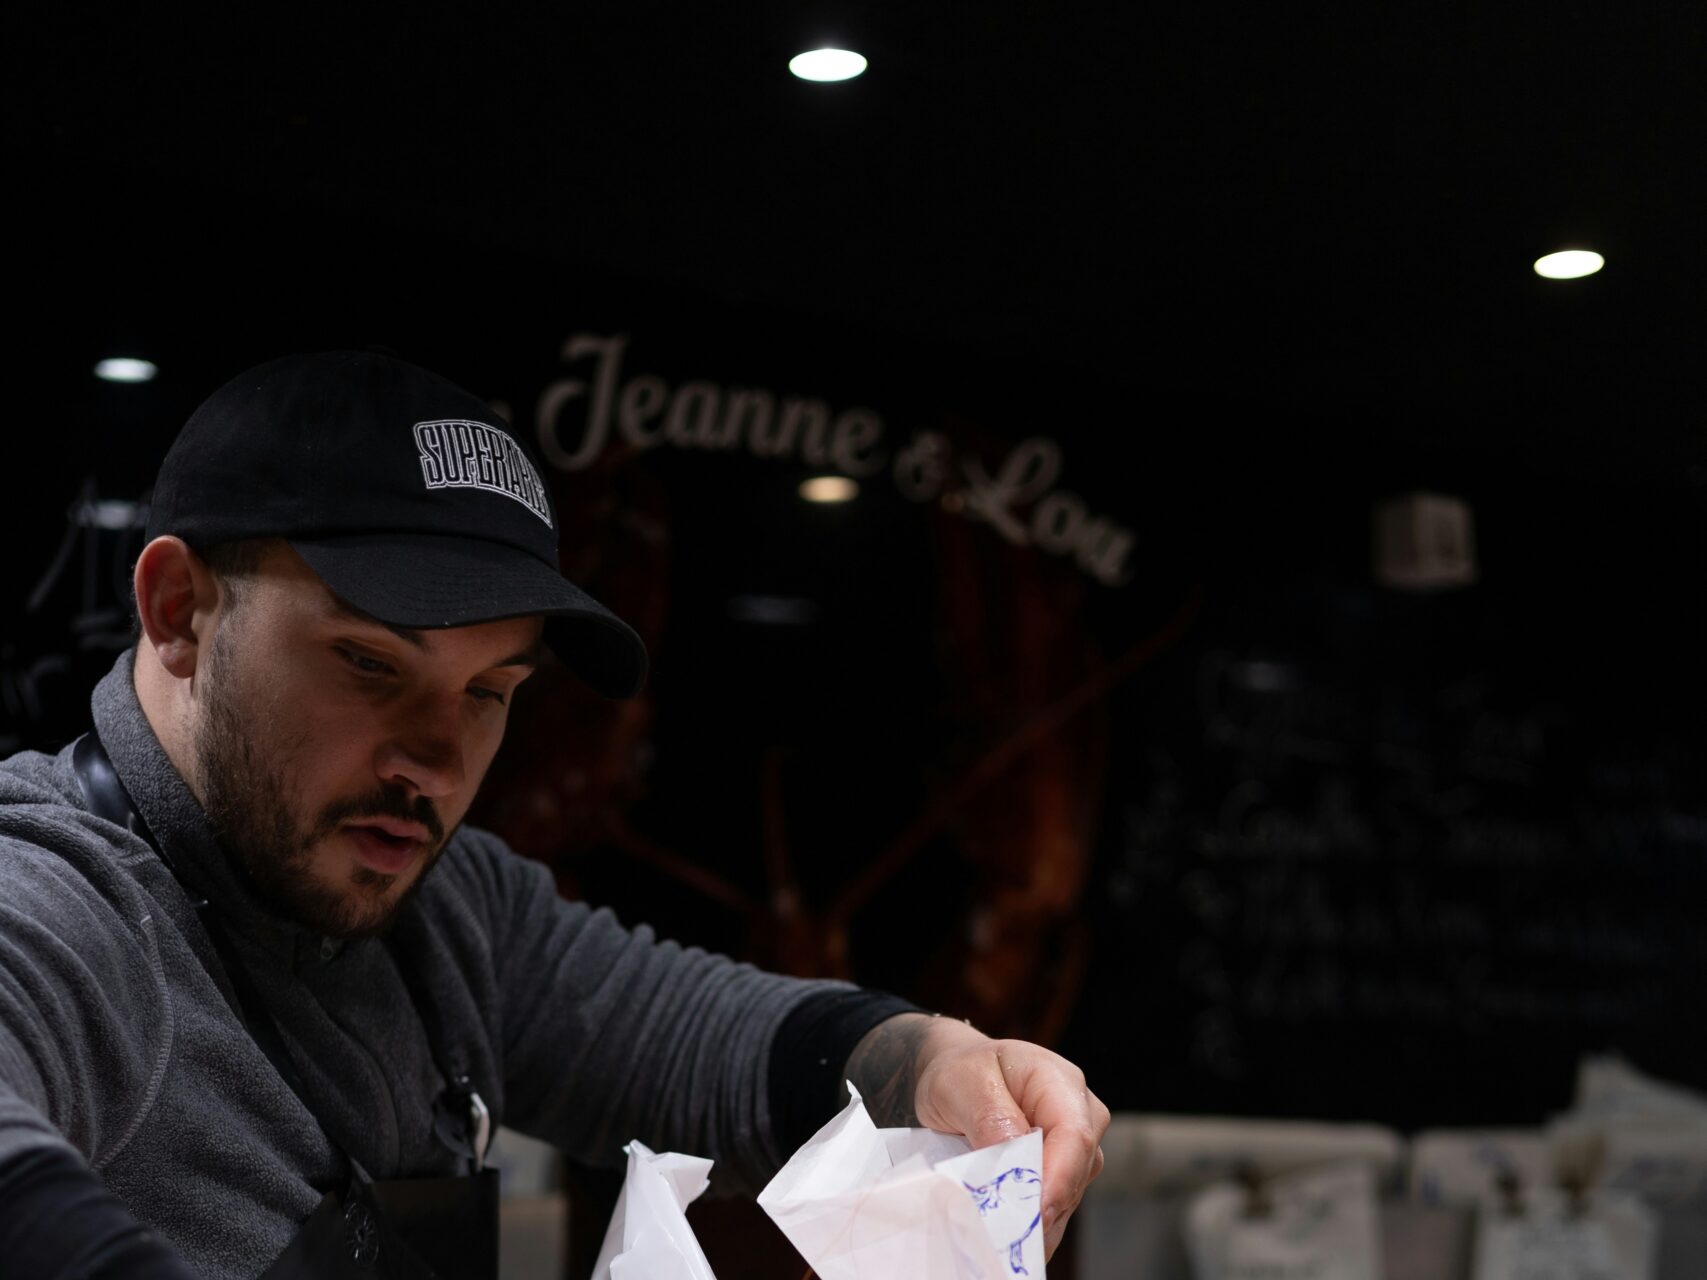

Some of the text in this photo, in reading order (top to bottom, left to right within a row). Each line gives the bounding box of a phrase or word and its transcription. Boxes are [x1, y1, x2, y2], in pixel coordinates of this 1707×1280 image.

[537, 331, 1135, 586] Jeanne & Lou
